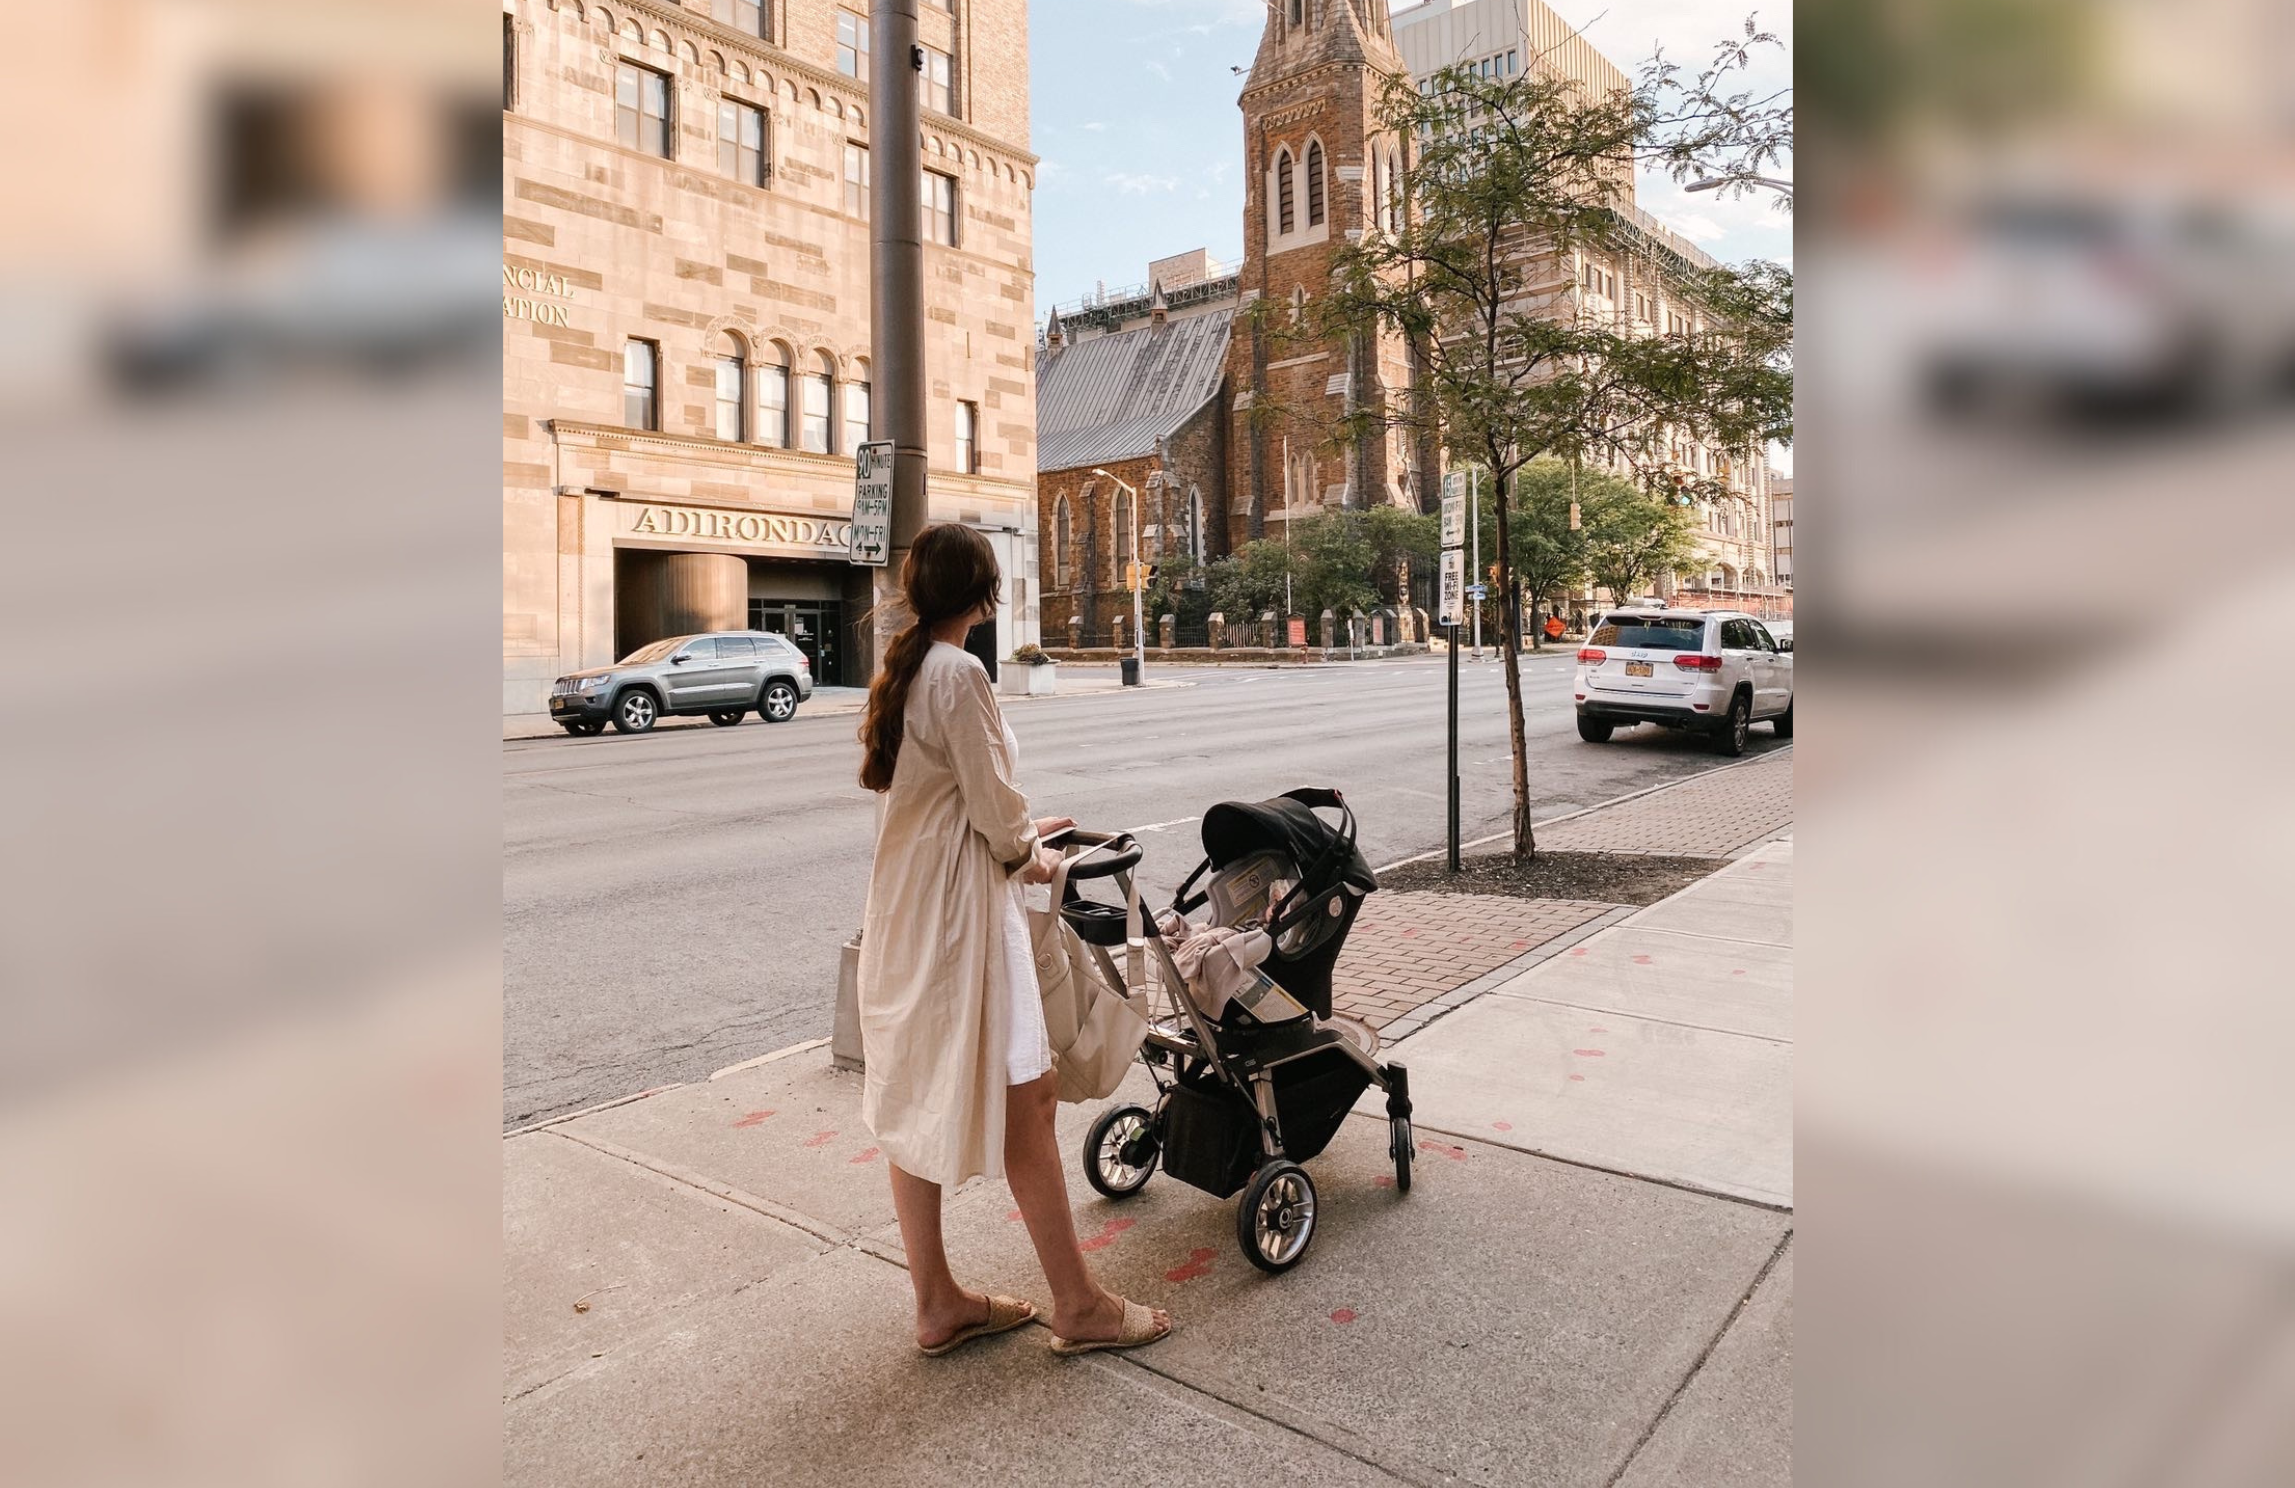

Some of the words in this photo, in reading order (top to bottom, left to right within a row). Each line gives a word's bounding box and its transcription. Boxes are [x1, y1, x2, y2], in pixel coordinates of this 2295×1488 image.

[858, 449, 871, 477] 90
[871, 453, 891, 469] MINUTE
[858, 483, 888, 499] PARKING
[1445, 571, 1458, 581] FREE
[1445, 581, 1458, 591] WI-FI
[1444, 590, 1458, 600] ZONE
